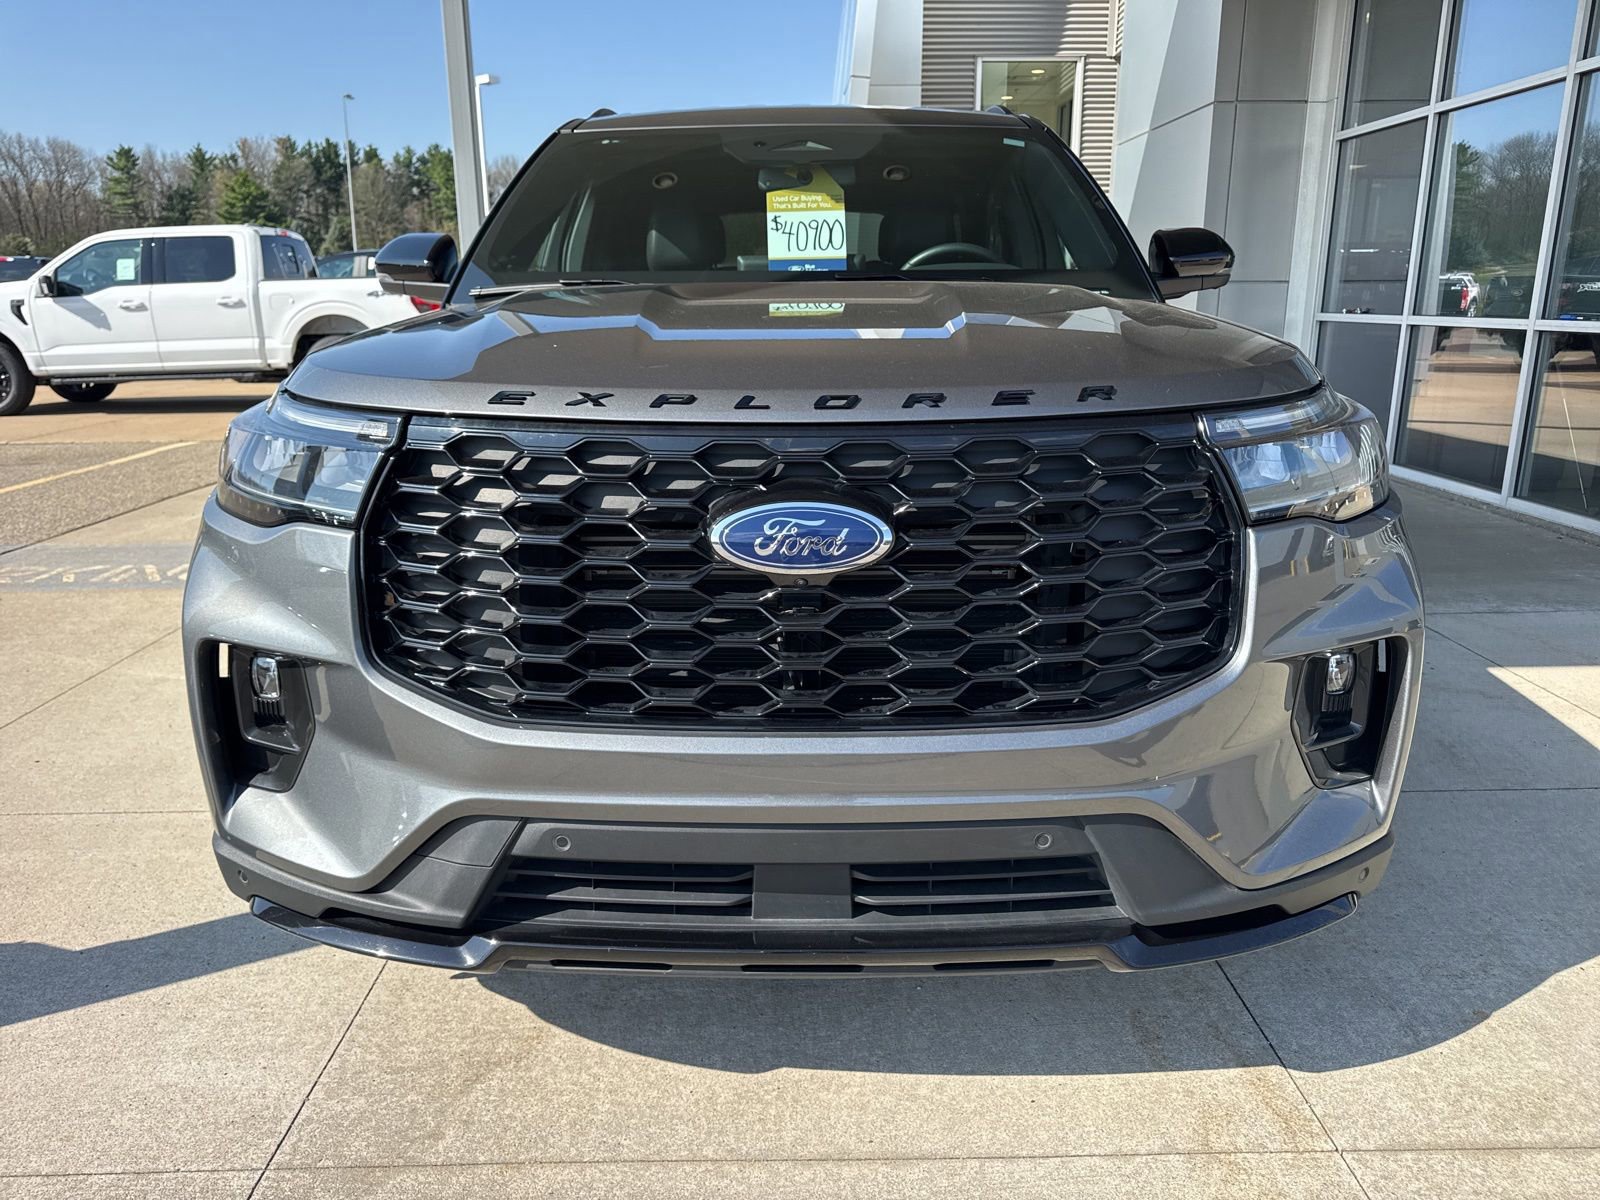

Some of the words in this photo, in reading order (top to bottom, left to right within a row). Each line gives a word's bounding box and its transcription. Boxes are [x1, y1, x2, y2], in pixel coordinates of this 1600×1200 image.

[801, 194, 822, 203] Buying
[488, 385, 1118, 410] EXPLORER
[754, 517, 849, 556] Ford
